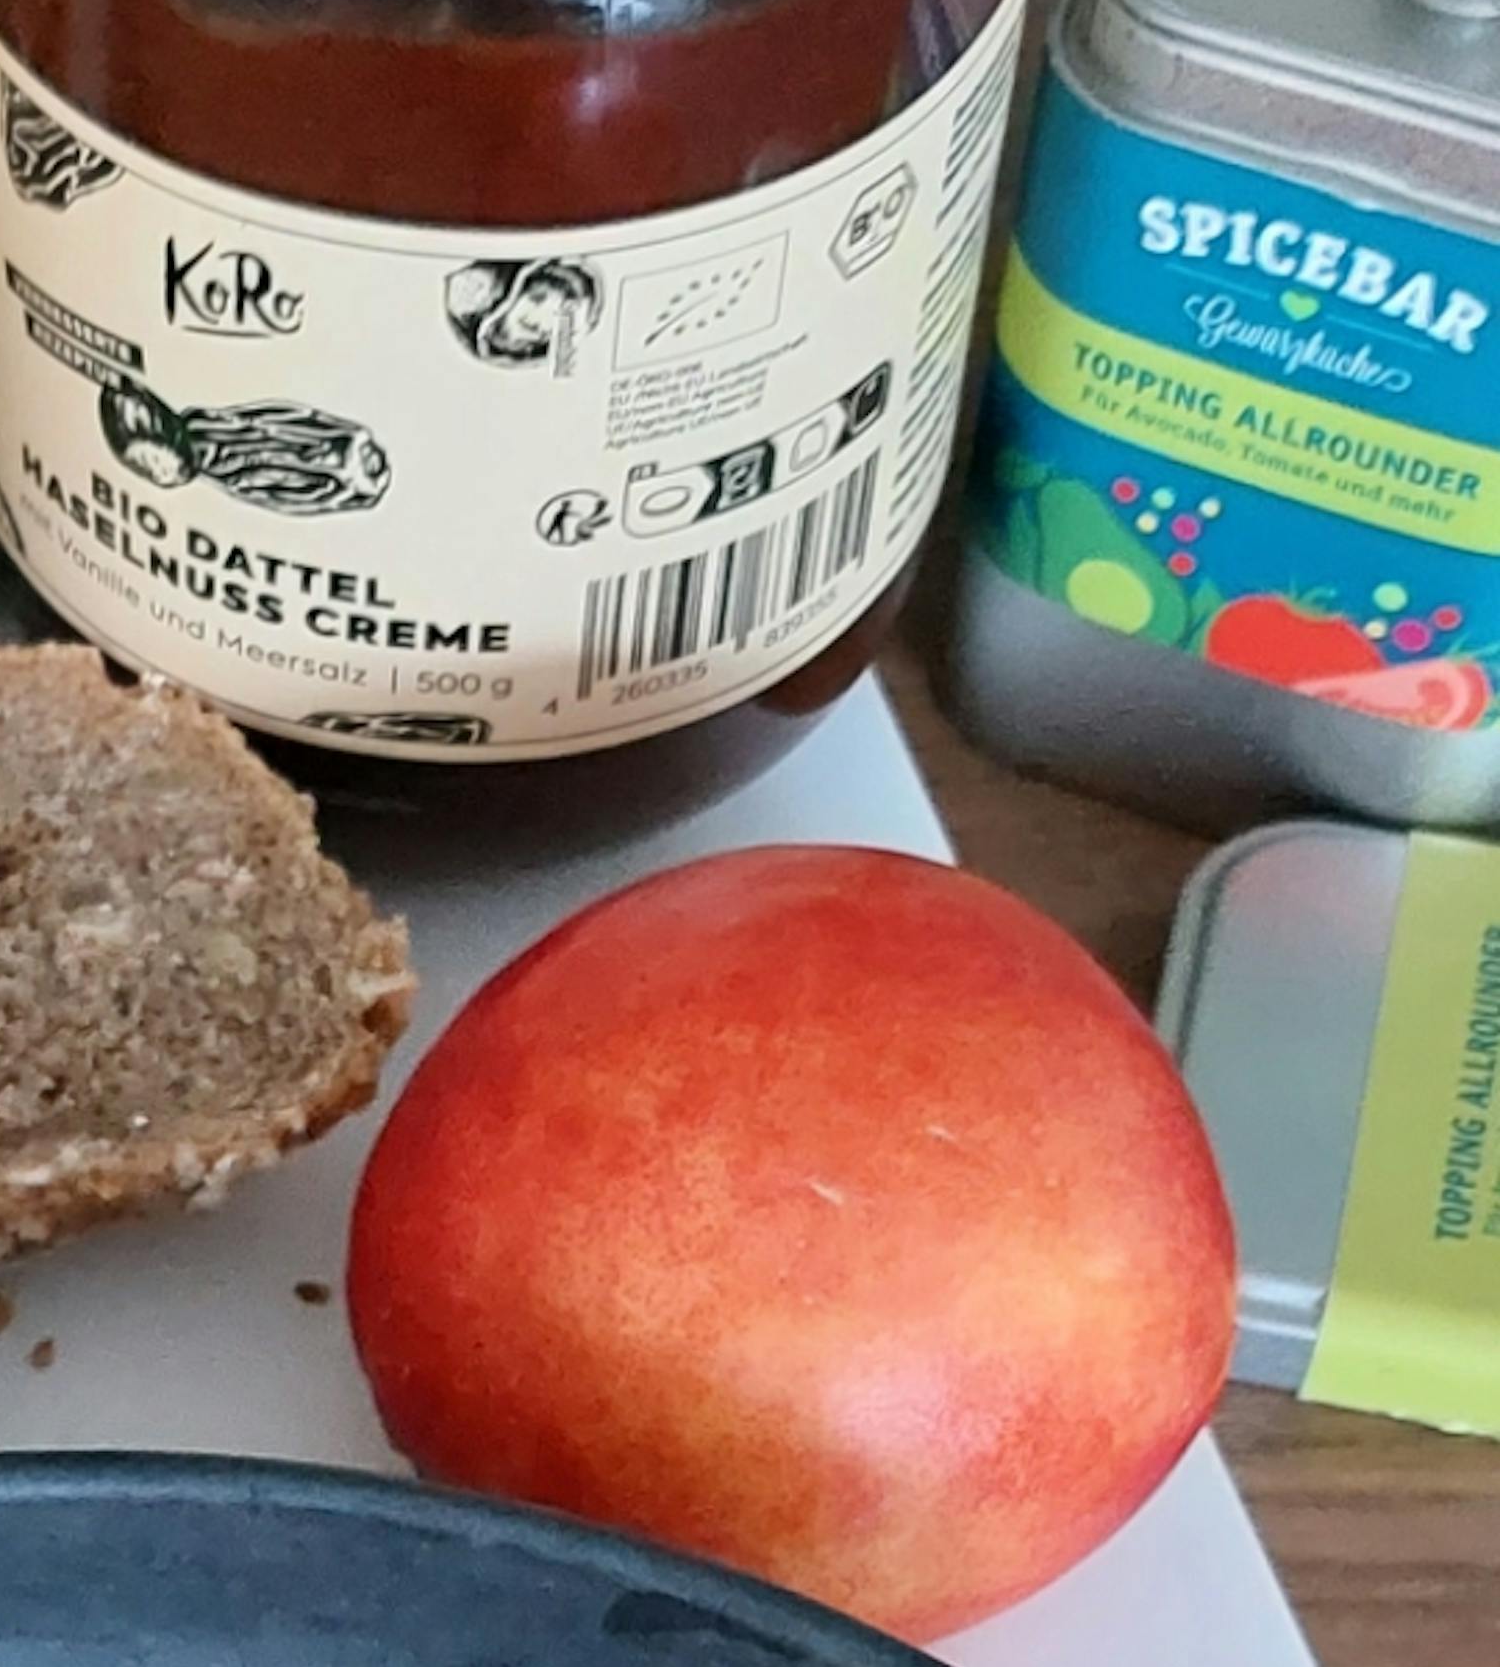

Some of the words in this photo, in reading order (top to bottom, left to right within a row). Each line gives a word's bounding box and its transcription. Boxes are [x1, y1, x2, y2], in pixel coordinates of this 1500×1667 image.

[164, 234, 306, 336] KoRo
[1138, 196, 1490, 355] SPICEBAR
[1073, 341, 1223, 421] TOPPING
[1233, 403, 1484, 501] ALLROUNDER
[1080, 383, 1122, 414] Für
[1125, 405, 1233, 458] Avocado,
[1240, 442, 1329, 486] Tomate
[1335, 472, 1385, 506] und
[1388, 492, 1458, 524] mehr
[21, 443, 285, 626] HASELNUSS
[304, 607, 512, 654] CREME
[57, 527, 141, 609] Vanille
[149, 598, 207, 641] und
[216, 630, 369, 689] Meersalz
[414, 670, 483, 696] 500
[492, 675, 514, 700] g
[90, 469, 169, 540] BIO
[185, 528, 397, 610] DATTEL
[1433, 1116, 1488, 1240] TOPPING
